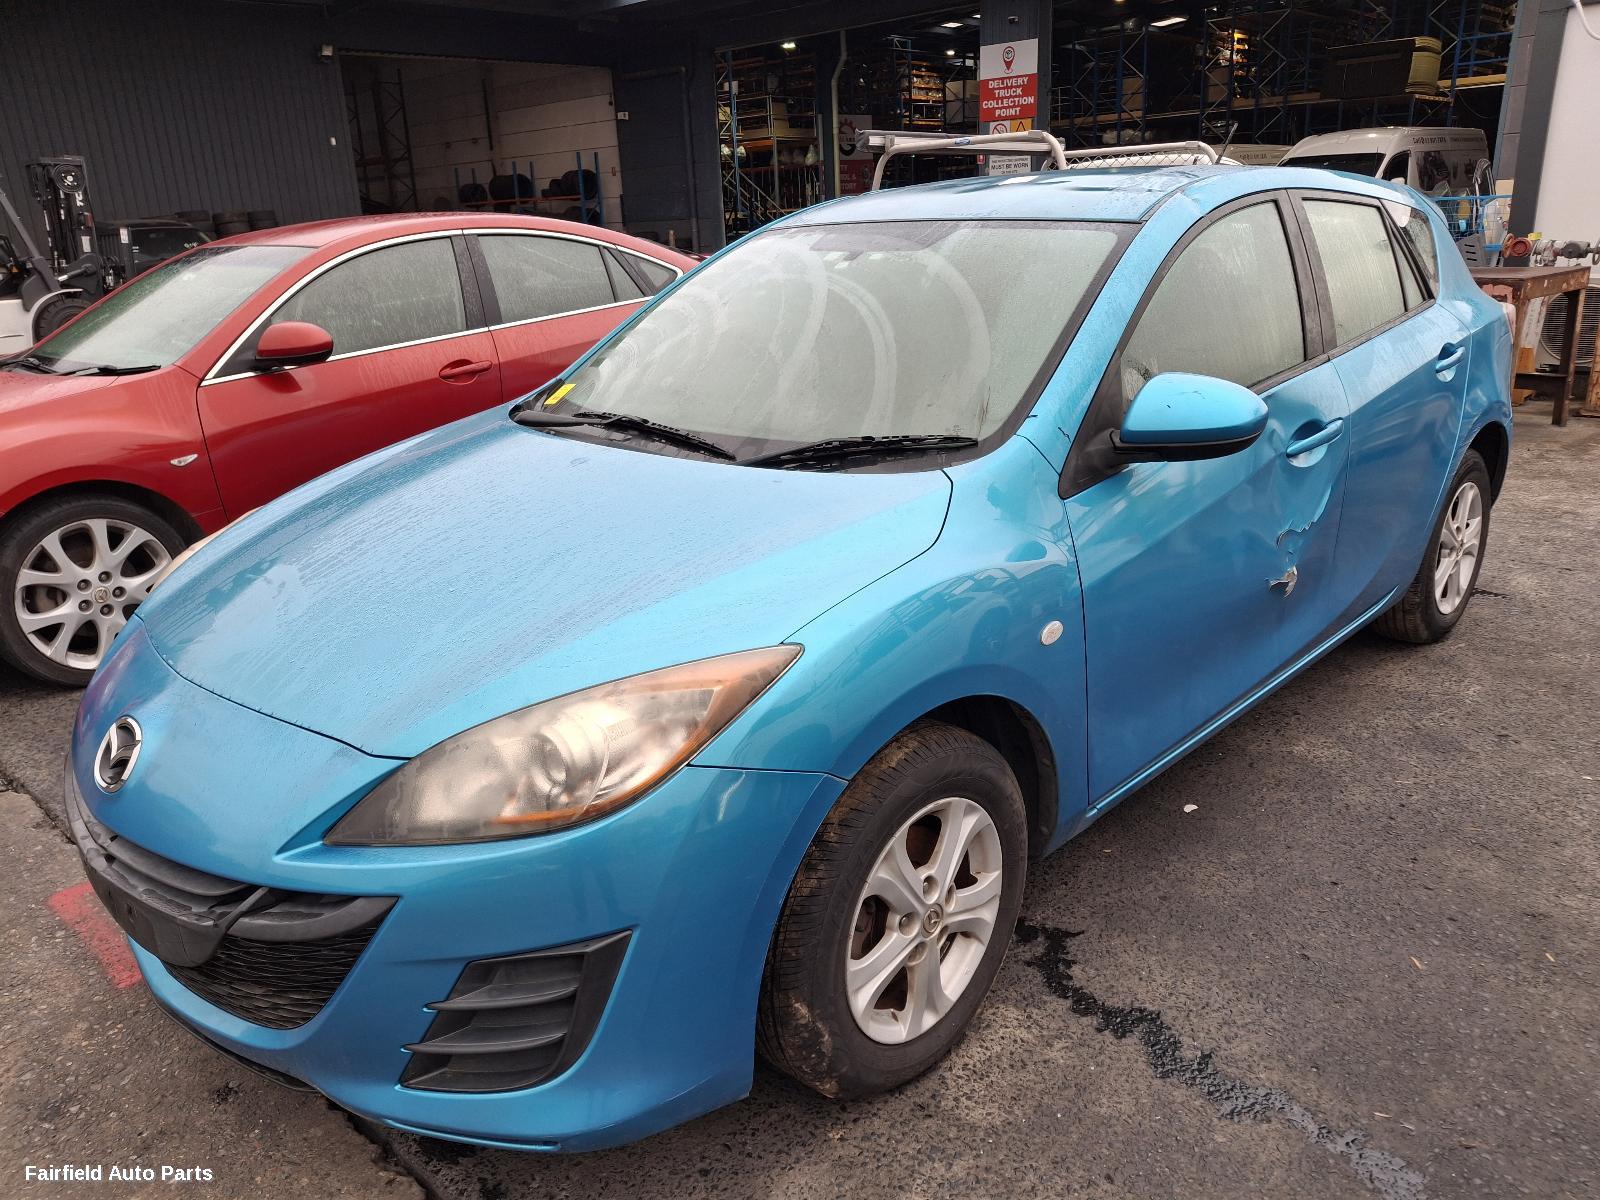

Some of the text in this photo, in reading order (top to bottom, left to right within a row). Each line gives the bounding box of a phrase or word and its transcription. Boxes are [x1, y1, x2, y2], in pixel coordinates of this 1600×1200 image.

[988, 76, 1029, 89] DELIVERY
[994, 87, 1023, 97] TRUCK
[982, 96, 1035, 108] COLLECTION
[995, 107, 1021, 117] POINT
